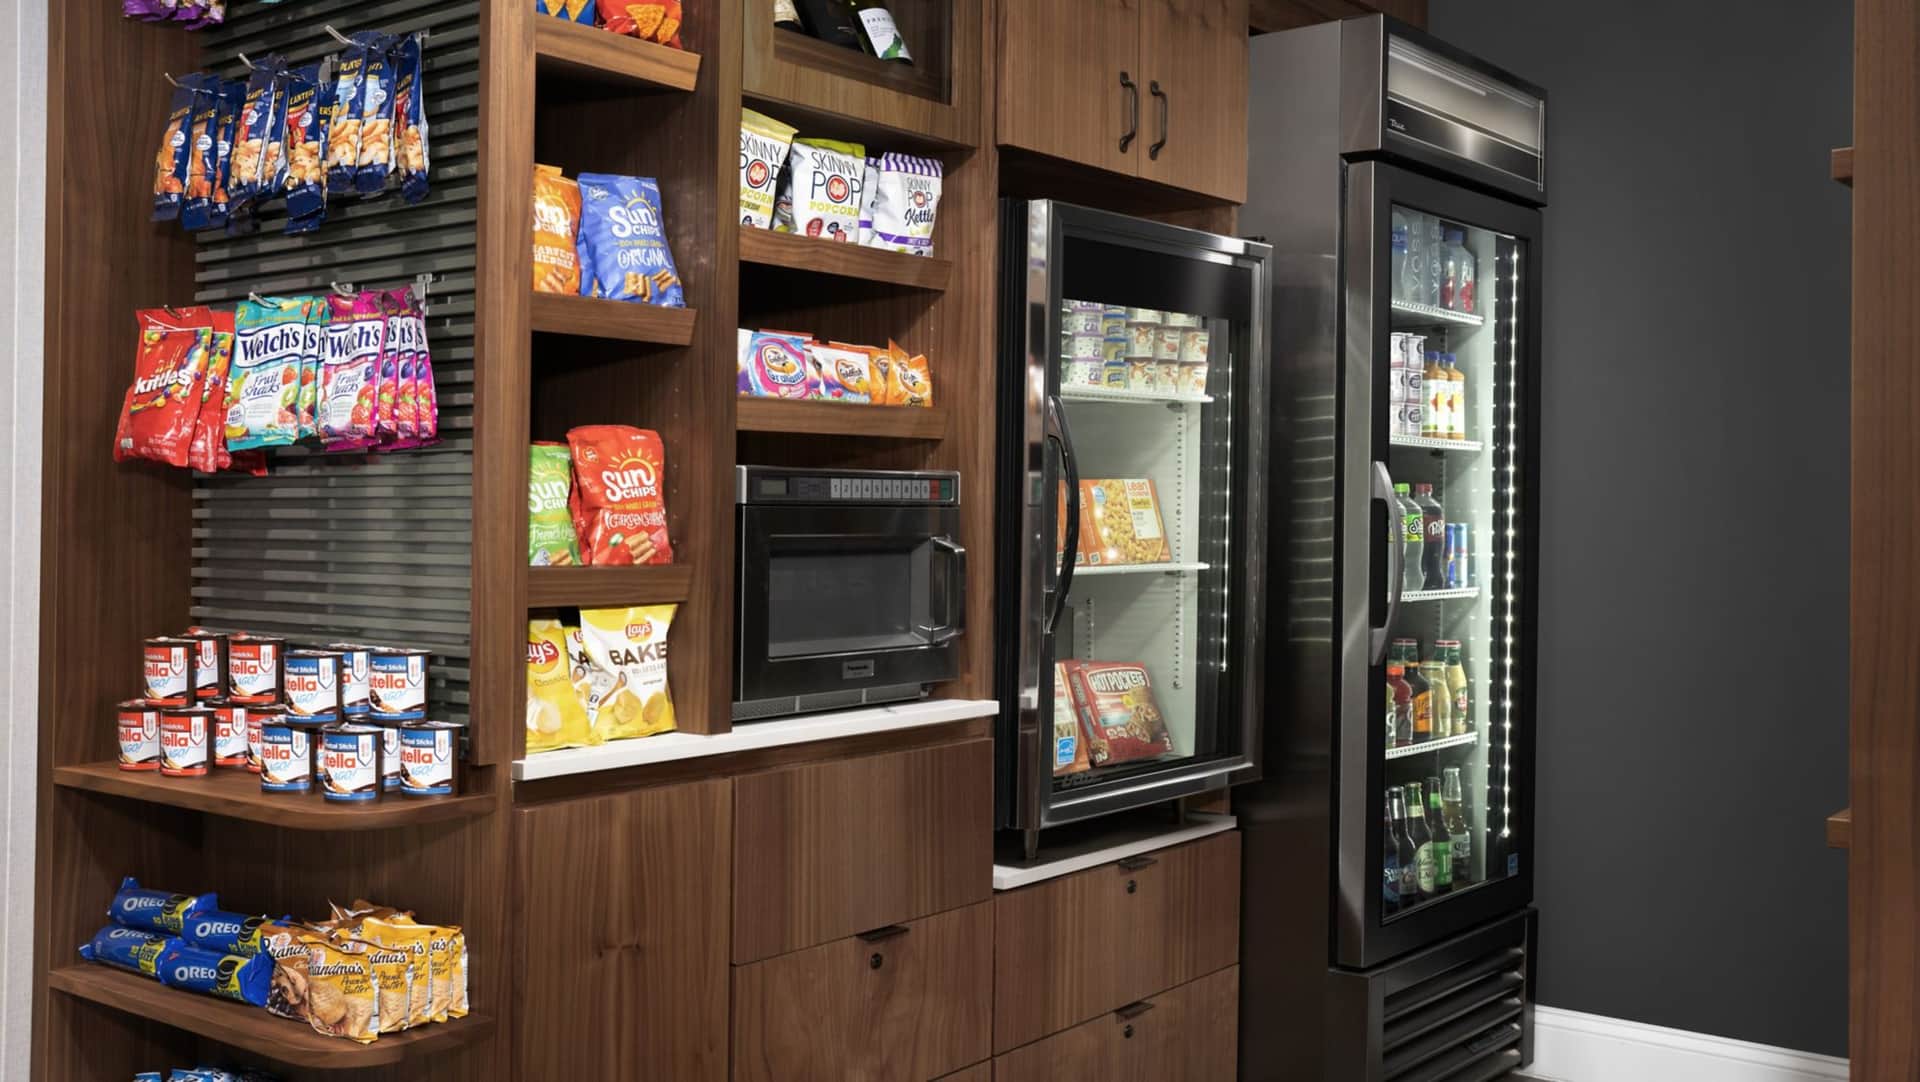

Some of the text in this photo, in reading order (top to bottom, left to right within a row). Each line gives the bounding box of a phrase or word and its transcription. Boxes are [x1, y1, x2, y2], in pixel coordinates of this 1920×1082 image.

[811, 152, 858, 178] SKINNY
[811, 170, 862, 206] POP
[907, 190, 934, 209] POP
[810, 201, 859, 217] POPCORN
[608, 204, 658, 238] Sun
[241, 327, 300, 361] Welch's
[255, 370, 280, 386] Fruit
[602, 467, 656, 502] Sun
[622, 486, 657, 499] CHIPS
[123, 896, 166, 912] OREO
[109, 928, 155, 940] OREO
[196, 922, 242, 938] OREO
[175, 966, 217, 981] OREO
